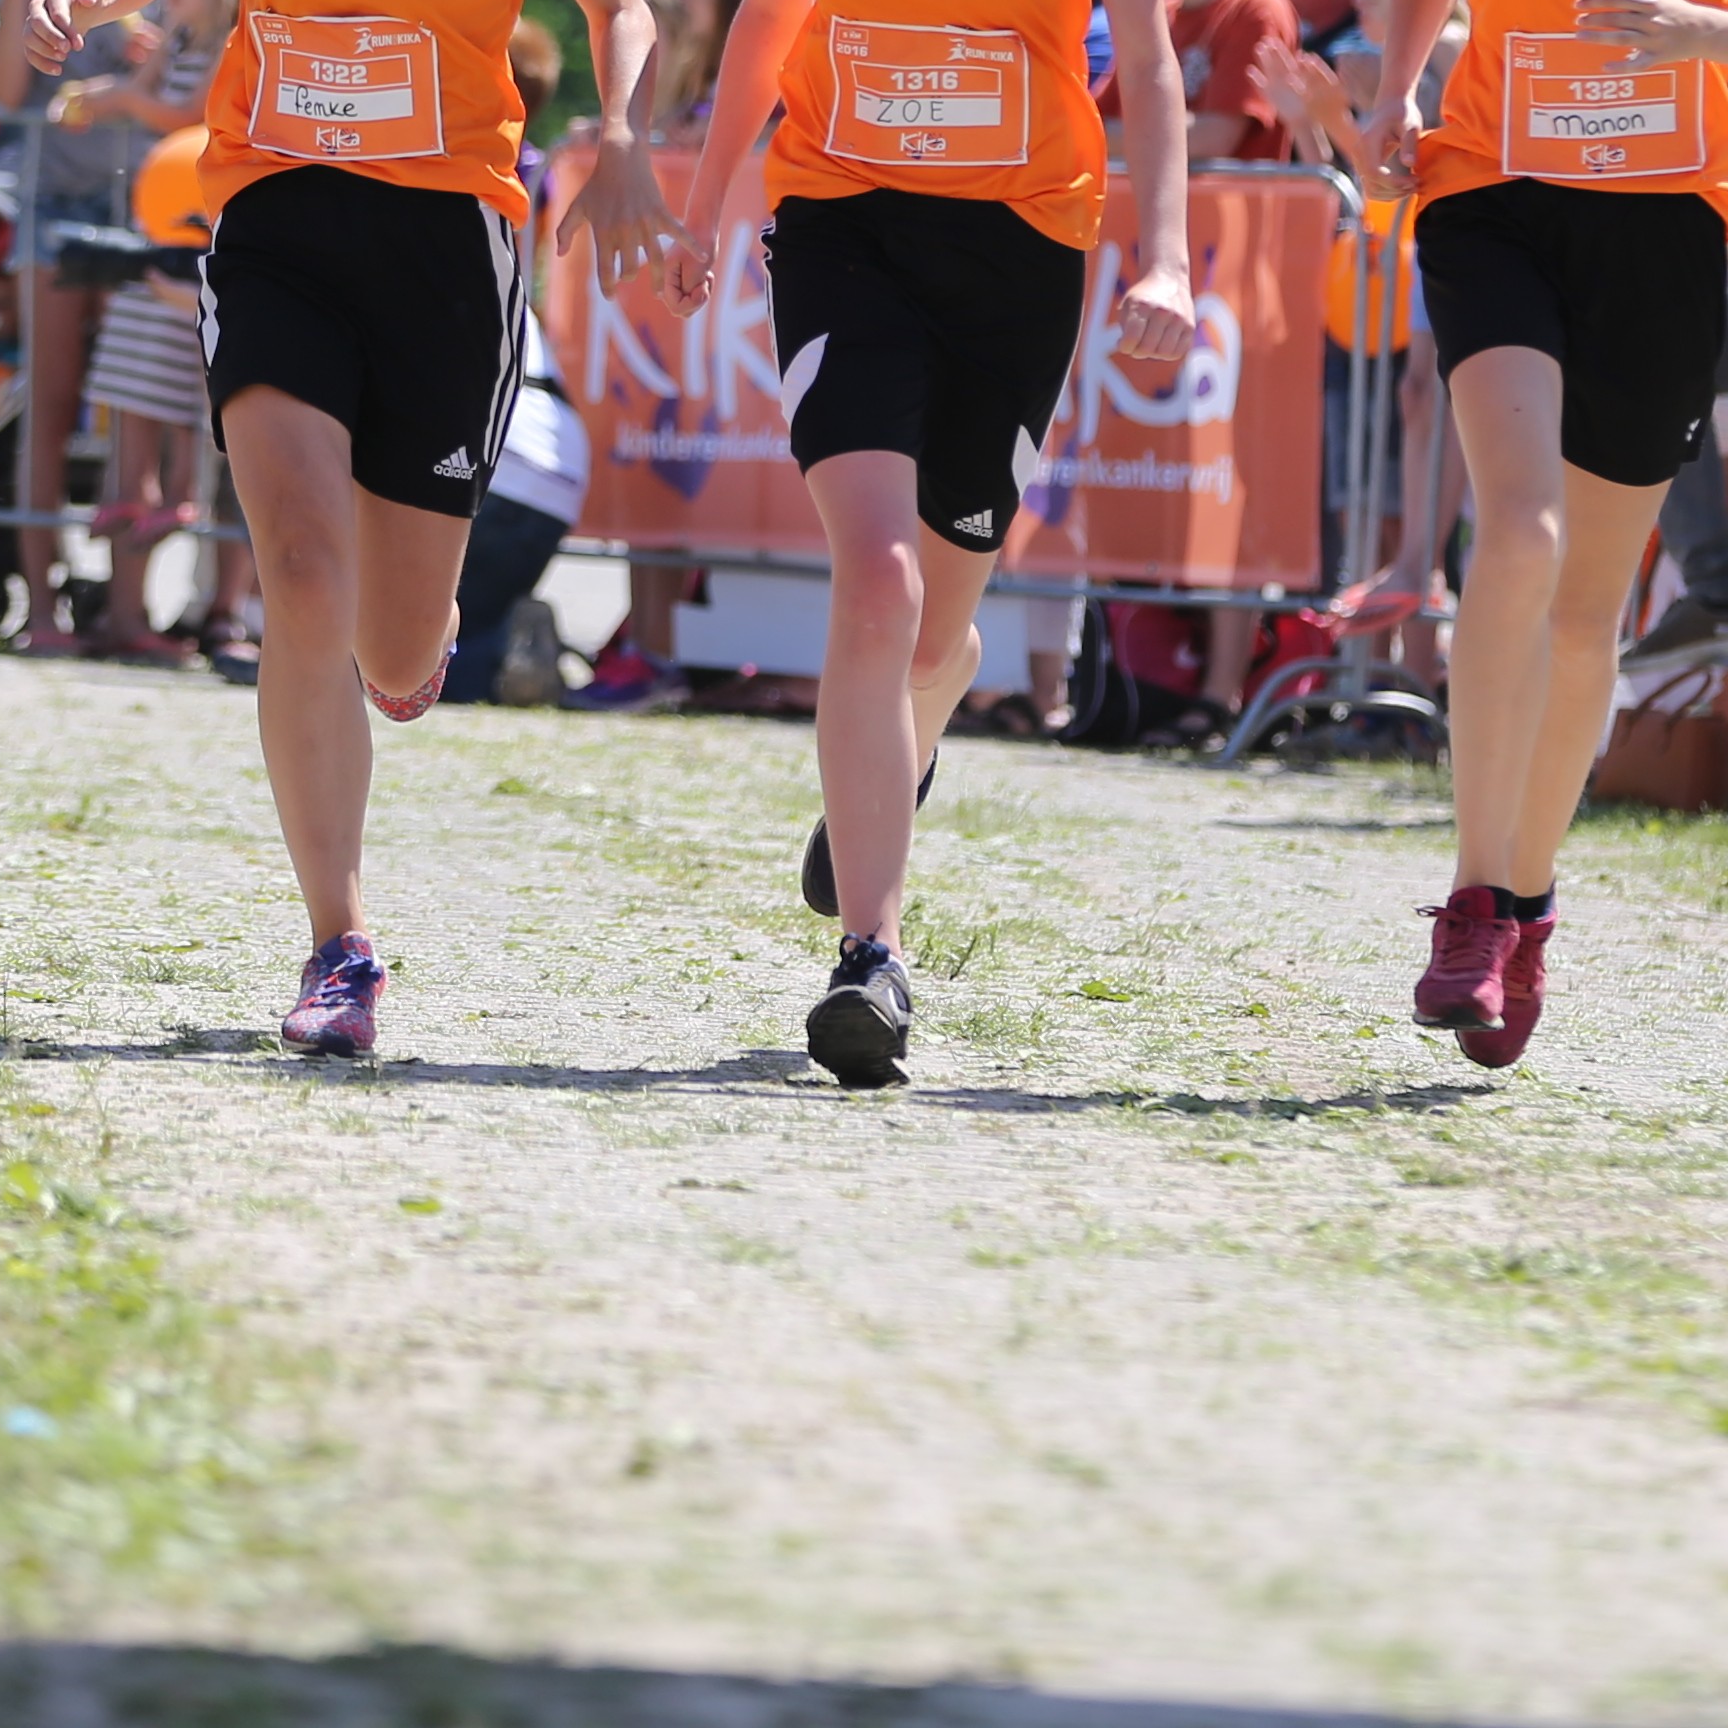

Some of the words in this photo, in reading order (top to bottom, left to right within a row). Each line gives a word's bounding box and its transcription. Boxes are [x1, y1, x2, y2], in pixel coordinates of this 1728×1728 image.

[397, 33, 422, 45] KIKA
[836, 43, 868, 57] 2016
[310, 61, 368, 84] 1322
[1514, 57, 1544, 70] 2016
[890, 71, 959, 90] 1316
[1568, 79, 1635, 101] 1323
[433, 463, 474, 480] adidas
[954, 519, 994, 539] adidas
